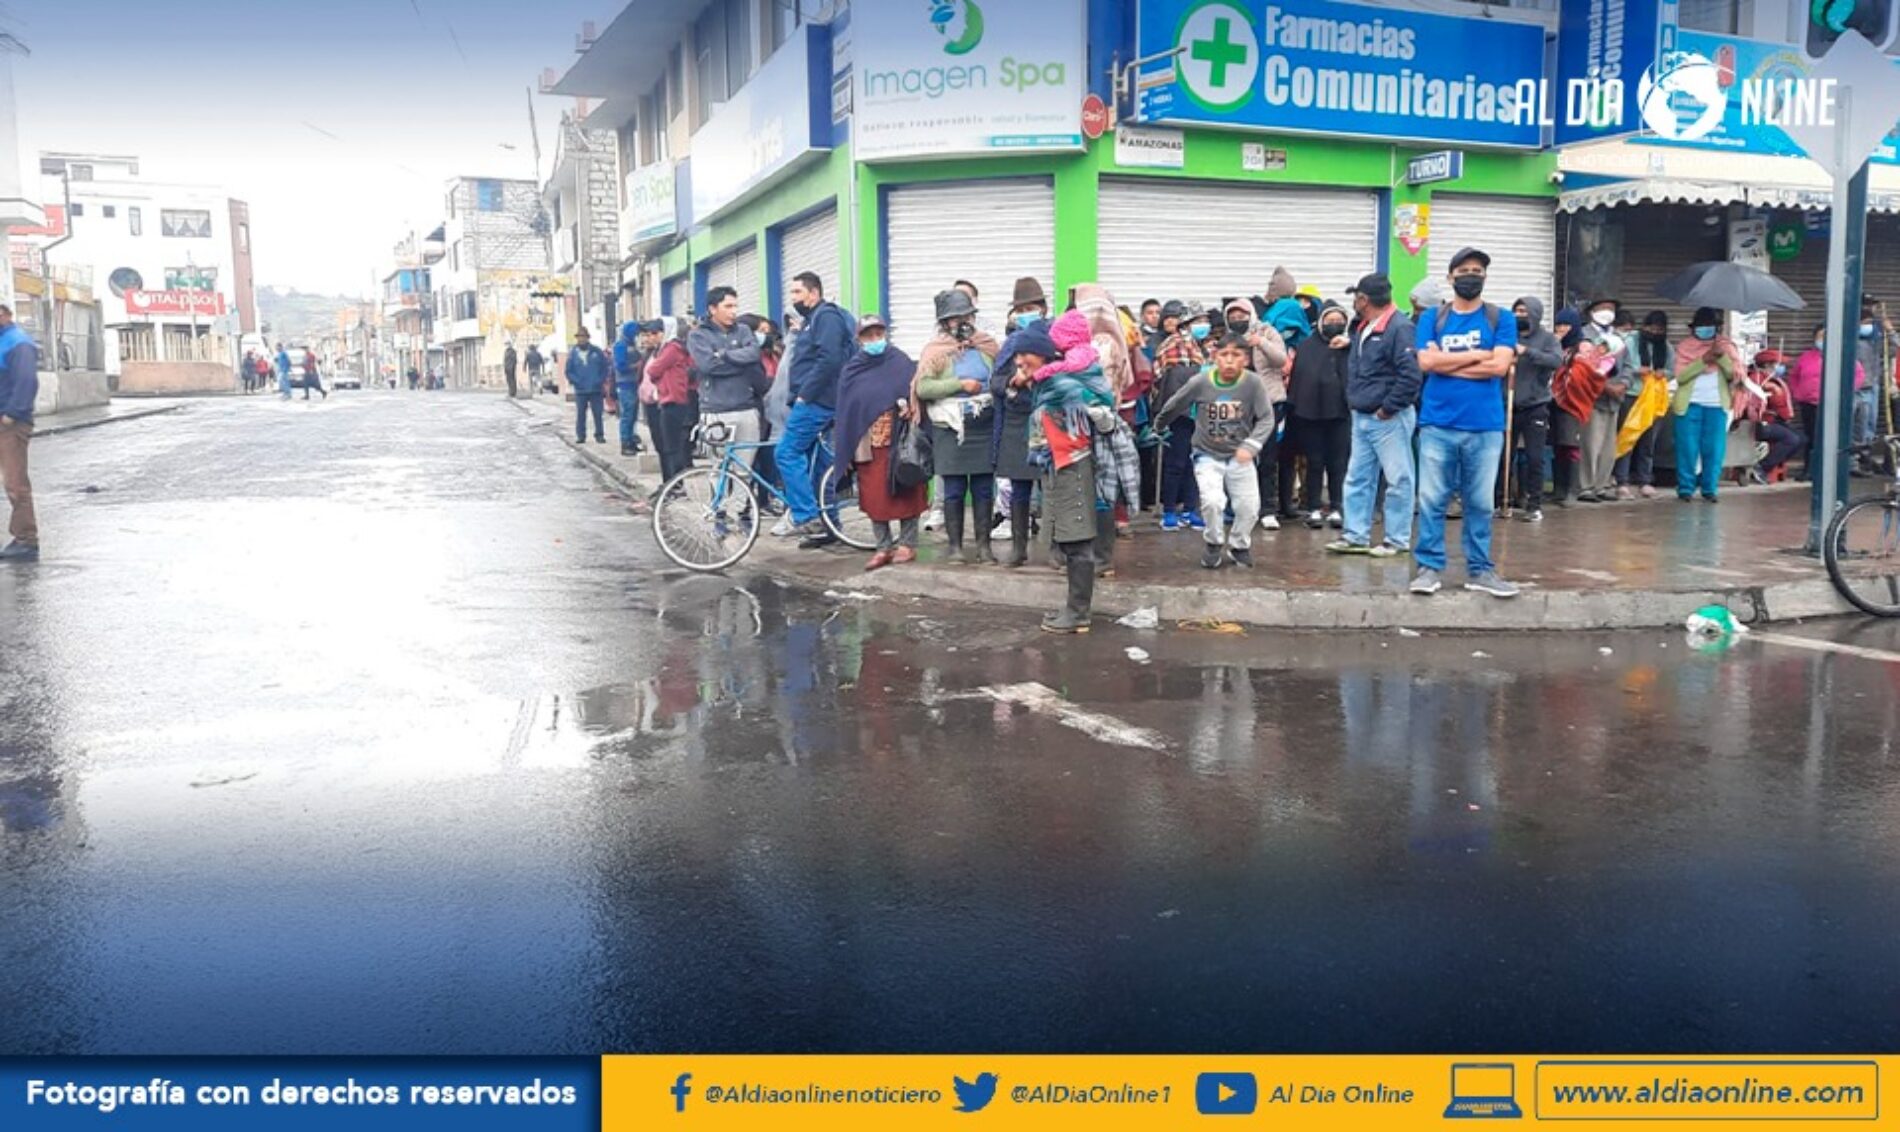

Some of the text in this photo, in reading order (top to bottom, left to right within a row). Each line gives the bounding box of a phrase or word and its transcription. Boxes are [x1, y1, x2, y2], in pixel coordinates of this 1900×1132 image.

[1265, 5, 1416, 60] Farmacias
[864, 56, 1065, 98] Imagen Spa
[1264, 54, 1516, 123] Comunitarias
[1128, 138, 1183, 150] AMAZONAS
[1409, 156, 1447, 181] TURNO
[1208, 403, 1240, 420] BOY
